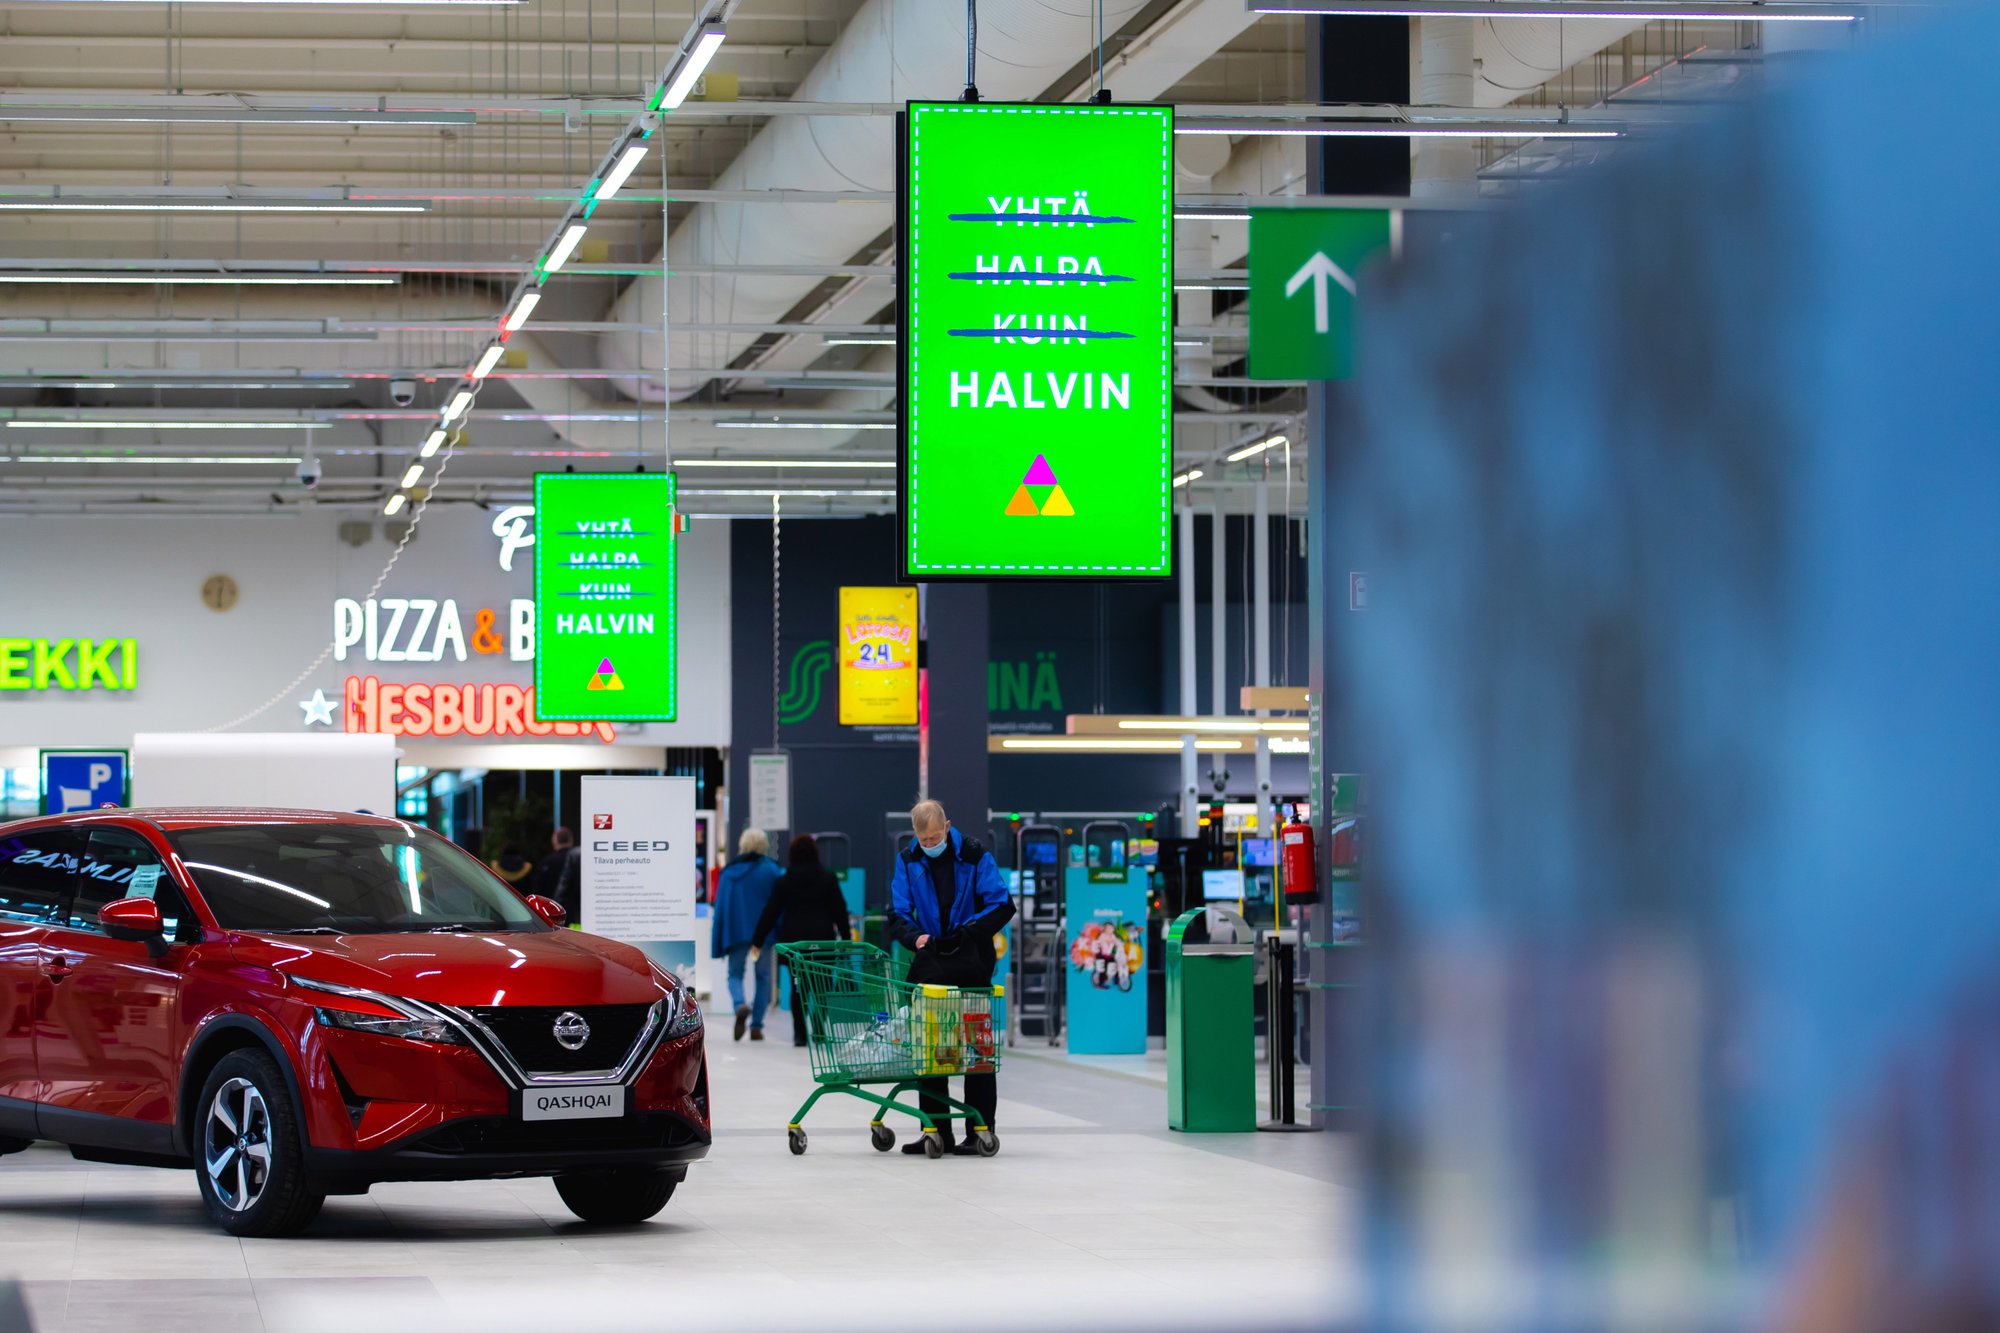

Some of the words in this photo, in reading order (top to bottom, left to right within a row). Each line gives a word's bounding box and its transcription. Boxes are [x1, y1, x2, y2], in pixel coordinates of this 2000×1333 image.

[987, 190, 1094, 228] YHTÄ
[975, 255, 1107, 287] HALPA
[993, 314, 1087, 345] KUIN
[950, 371, 1130, 410] HALVIN
[576, 518, 634, 538] YHTÄ
[569, 552, 641, 569] HALPA
[579, 583, 631, 601] KUIN
[334, 599, 467, 661] PIZZA
[471, 608, 504, 654] &
[556, 613, 655, 634] HALVIN
[0, 637, 138, 691] EKKI
[345, 676, 616, 744] HESBUR
[90, 763, 112, 790] P
[593, 841, 670, 852] CEED
[594, 856, 613, 864] Tilava
[615, 856, 651, 865] perheauto
[537, 1094, 611, 1112] QASHQAI
